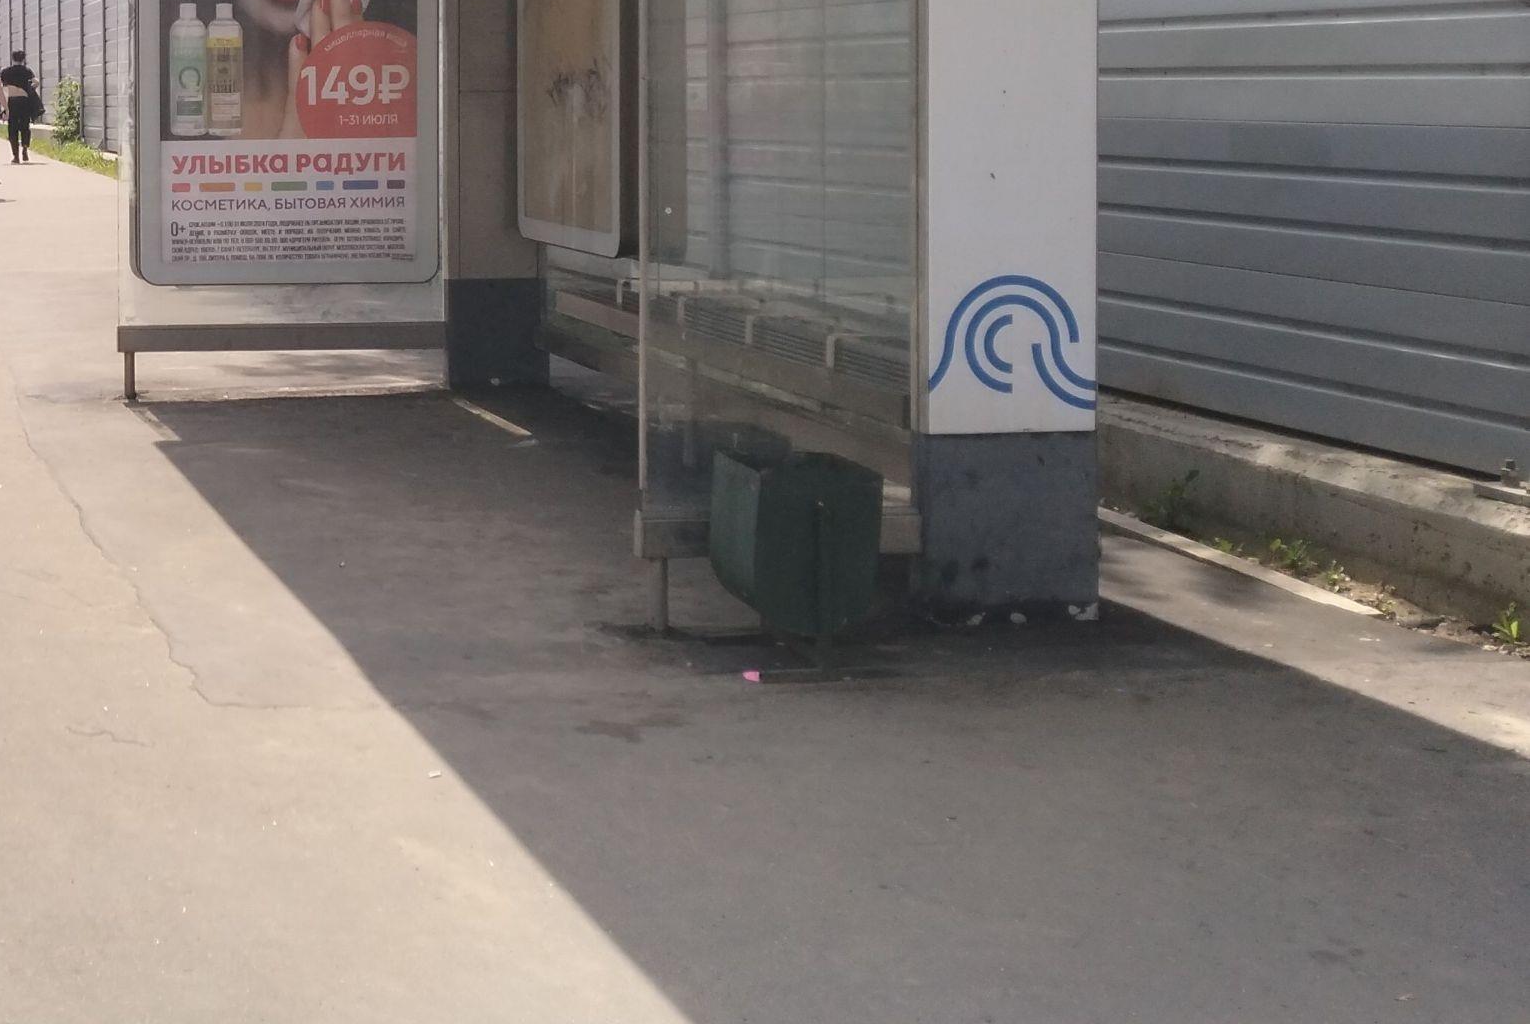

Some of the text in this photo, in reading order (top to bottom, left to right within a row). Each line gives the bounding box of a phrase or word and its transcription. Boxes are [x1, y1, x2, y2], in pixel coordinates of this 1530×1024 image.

[362, 114, 398, 125] ИЮЛЯ
[171, 196, 406, 212] КОСМЕТИКА, БЫТОВАЯ ХИМИЯ
